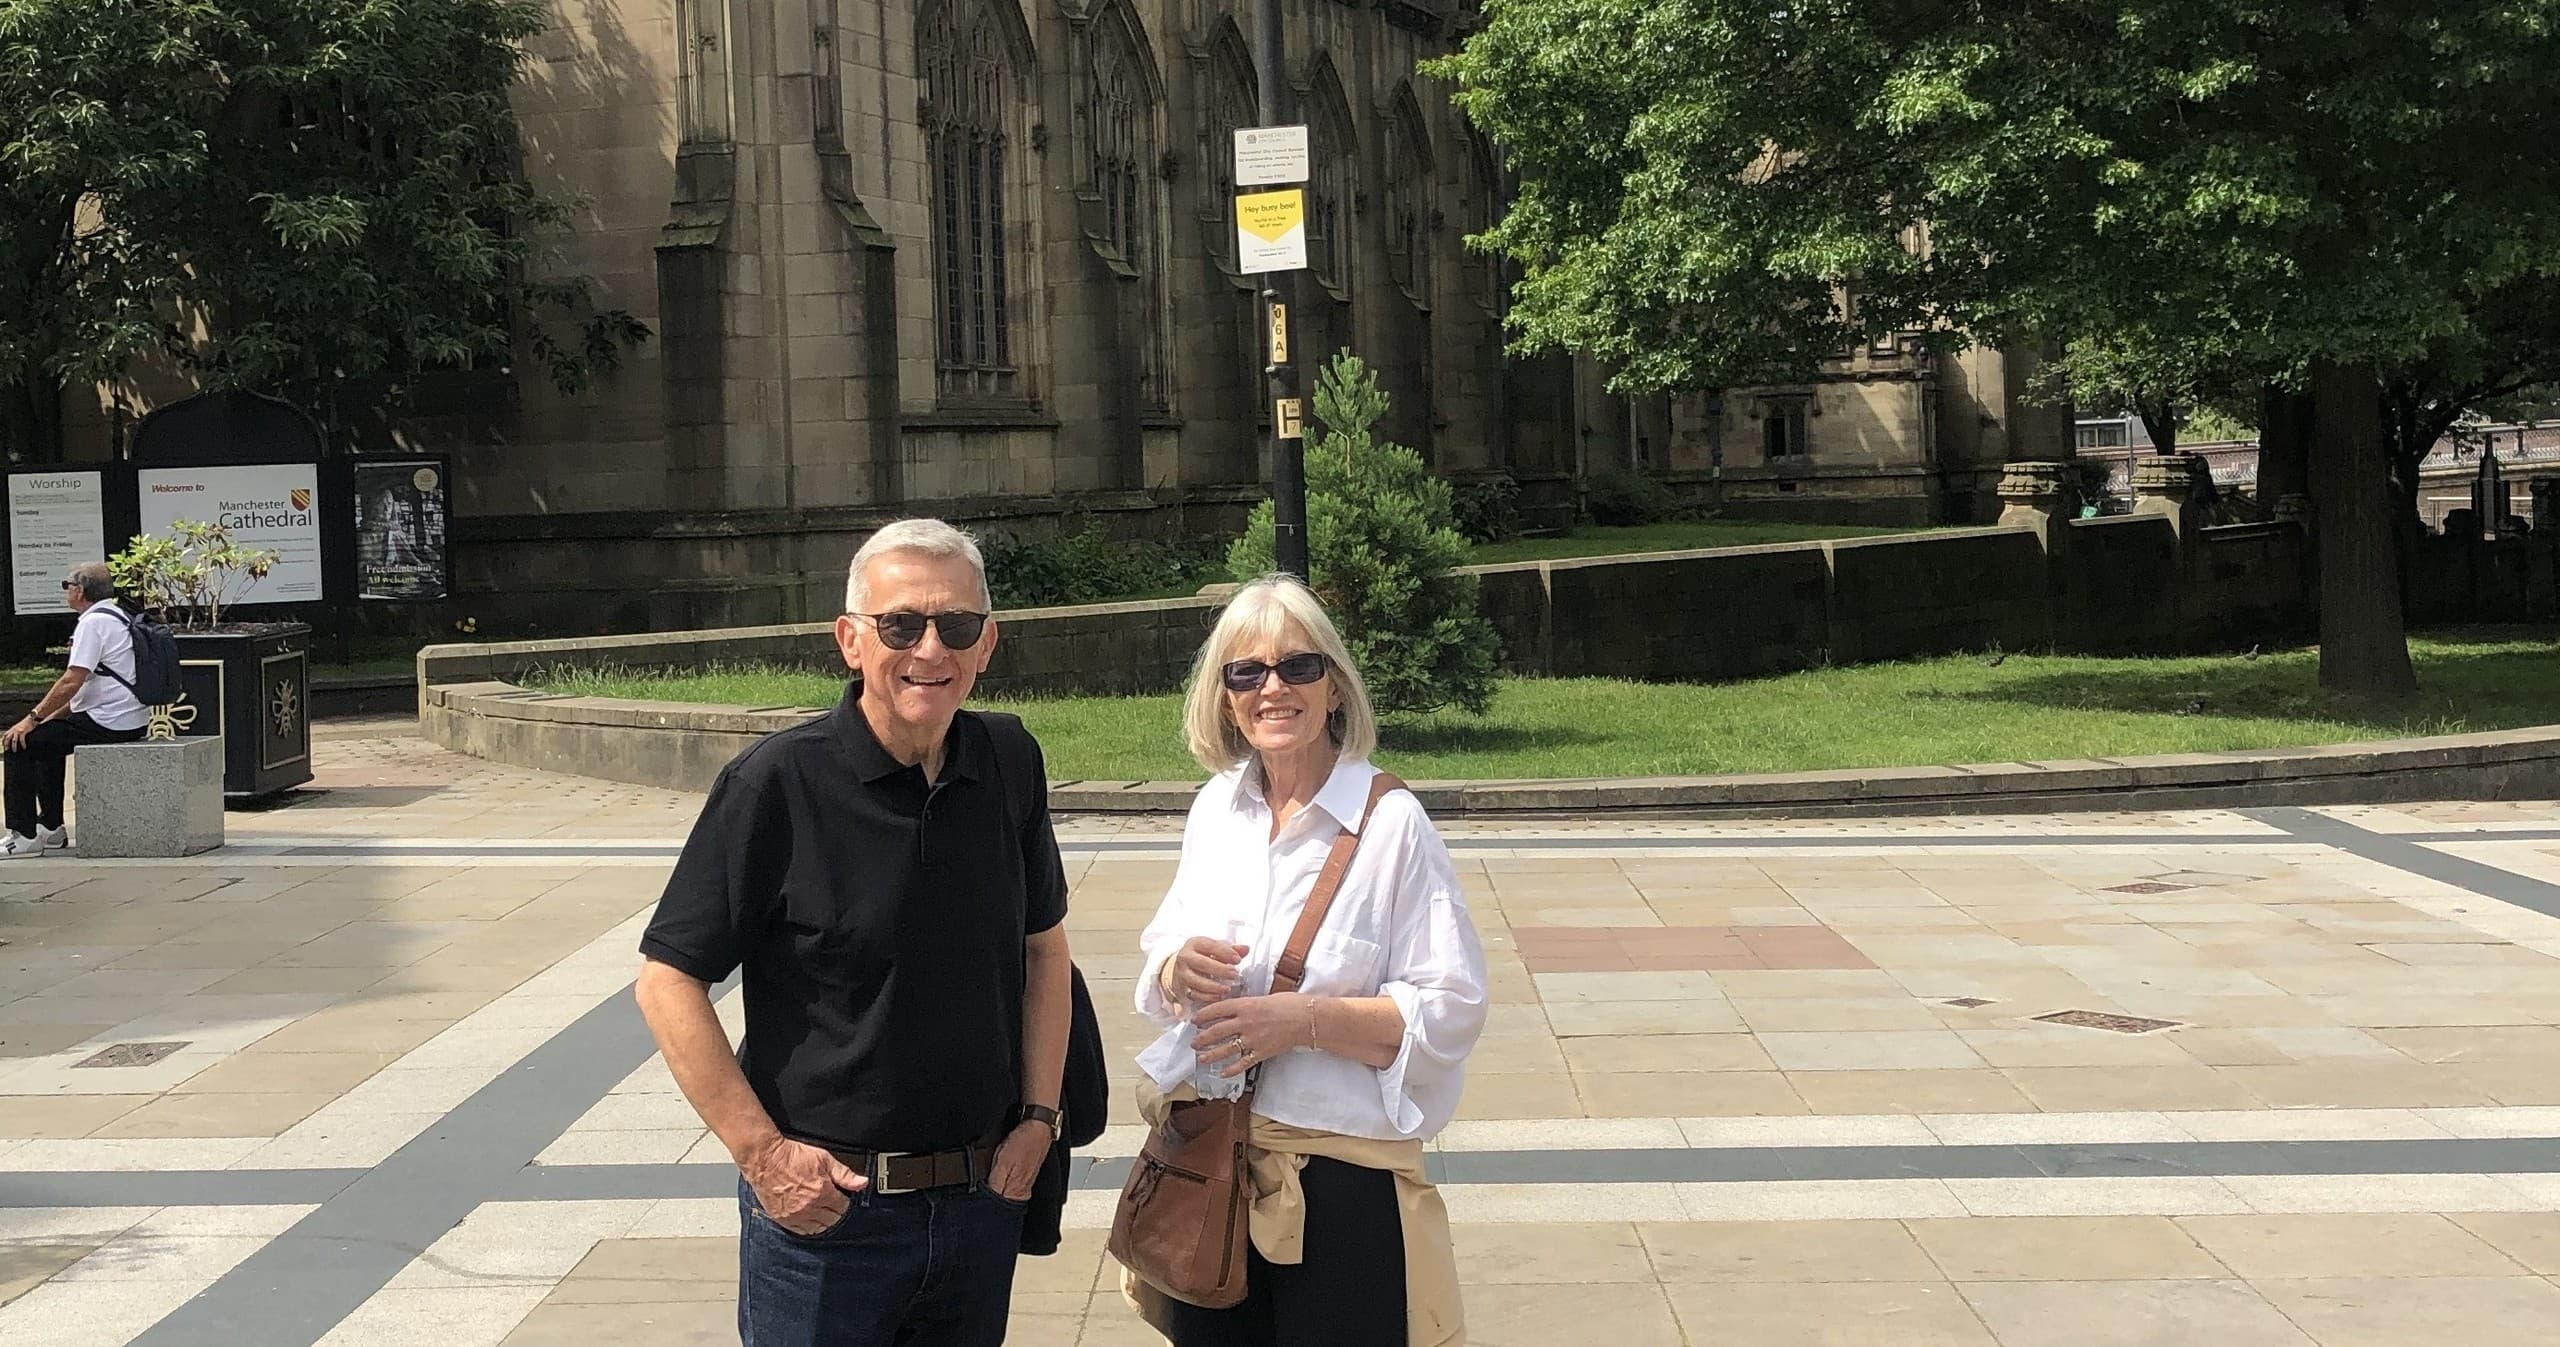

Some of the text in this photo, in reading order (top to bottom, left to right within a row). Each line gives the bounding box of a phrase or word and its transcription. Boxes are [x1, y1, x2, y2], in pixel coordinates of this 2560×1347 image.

[1244, 206, 1259, 214] Hey
[29, 478, 82, 490] Worship
[151, 483, 205, 493] Welcome to
[219, 500, 285, 511] Manchester
[219, 509, 312, 529] Cathedral
[366, 564, 385, 573] Free
[367, 575, 381, 584] All
